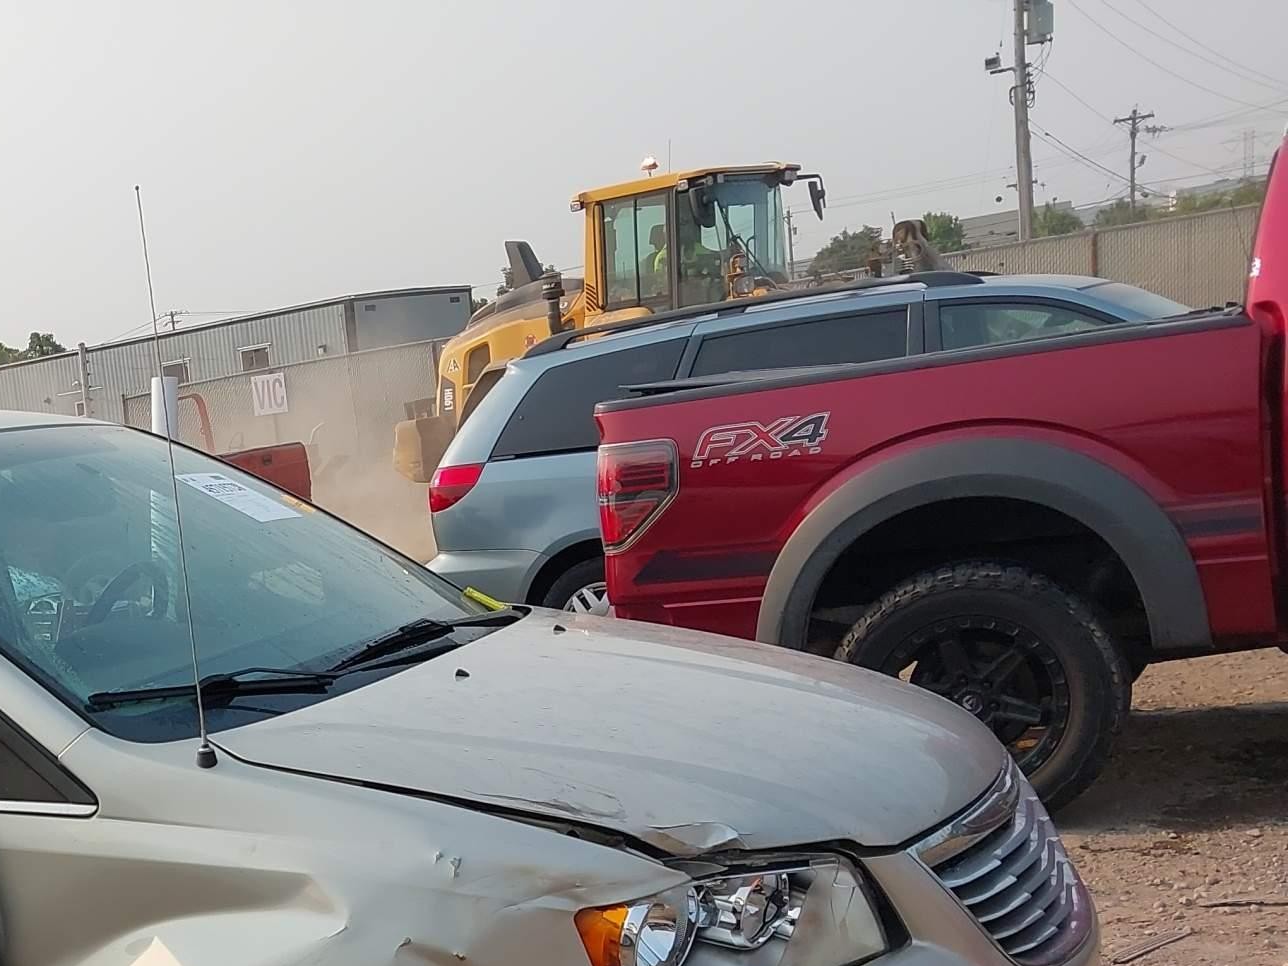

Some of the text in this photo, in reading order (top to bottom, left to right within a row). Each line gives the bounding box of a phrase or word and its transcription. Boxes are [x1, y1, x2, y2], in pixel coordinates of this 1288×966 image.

[253, 378, 285, 410] VIC
[692, 411, 831, 460] FX4
[690, 446, 823, 468] OFF ROAD
